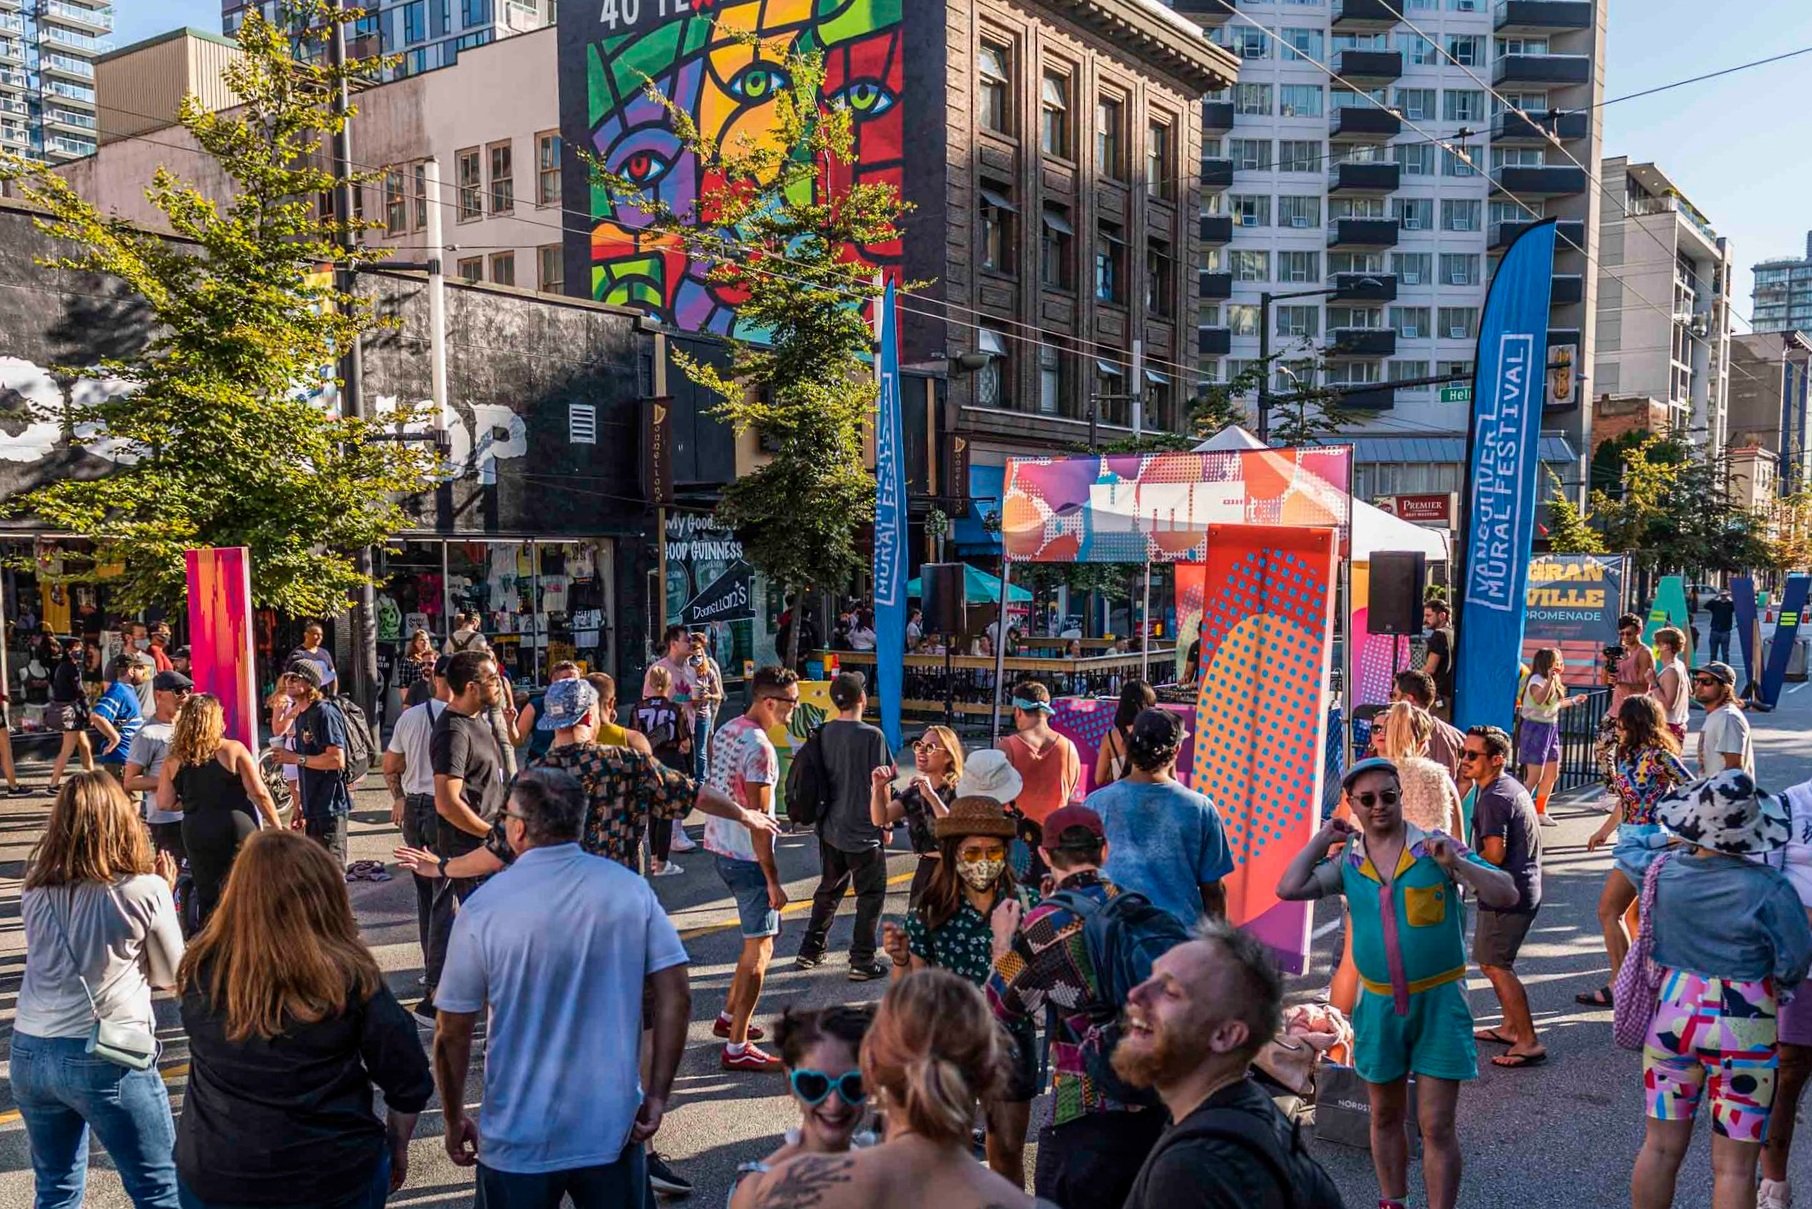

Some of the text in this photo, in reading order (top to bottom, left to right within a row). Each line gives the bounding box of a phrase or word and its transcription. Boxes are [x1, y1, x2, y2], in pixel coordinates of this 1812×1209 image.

[600, 0, 640, 30] 40
[1488, 347, 1524, 598] MURAL FESTIVAL
[665, 512, 685, 538] My
[691, 540, 743, 561] GUINNESS
[879, 515, 896, 595] MURAL
[1528, 562, 1604, 582] GRAN
[1526, 588, 1605, 608] VILLE
